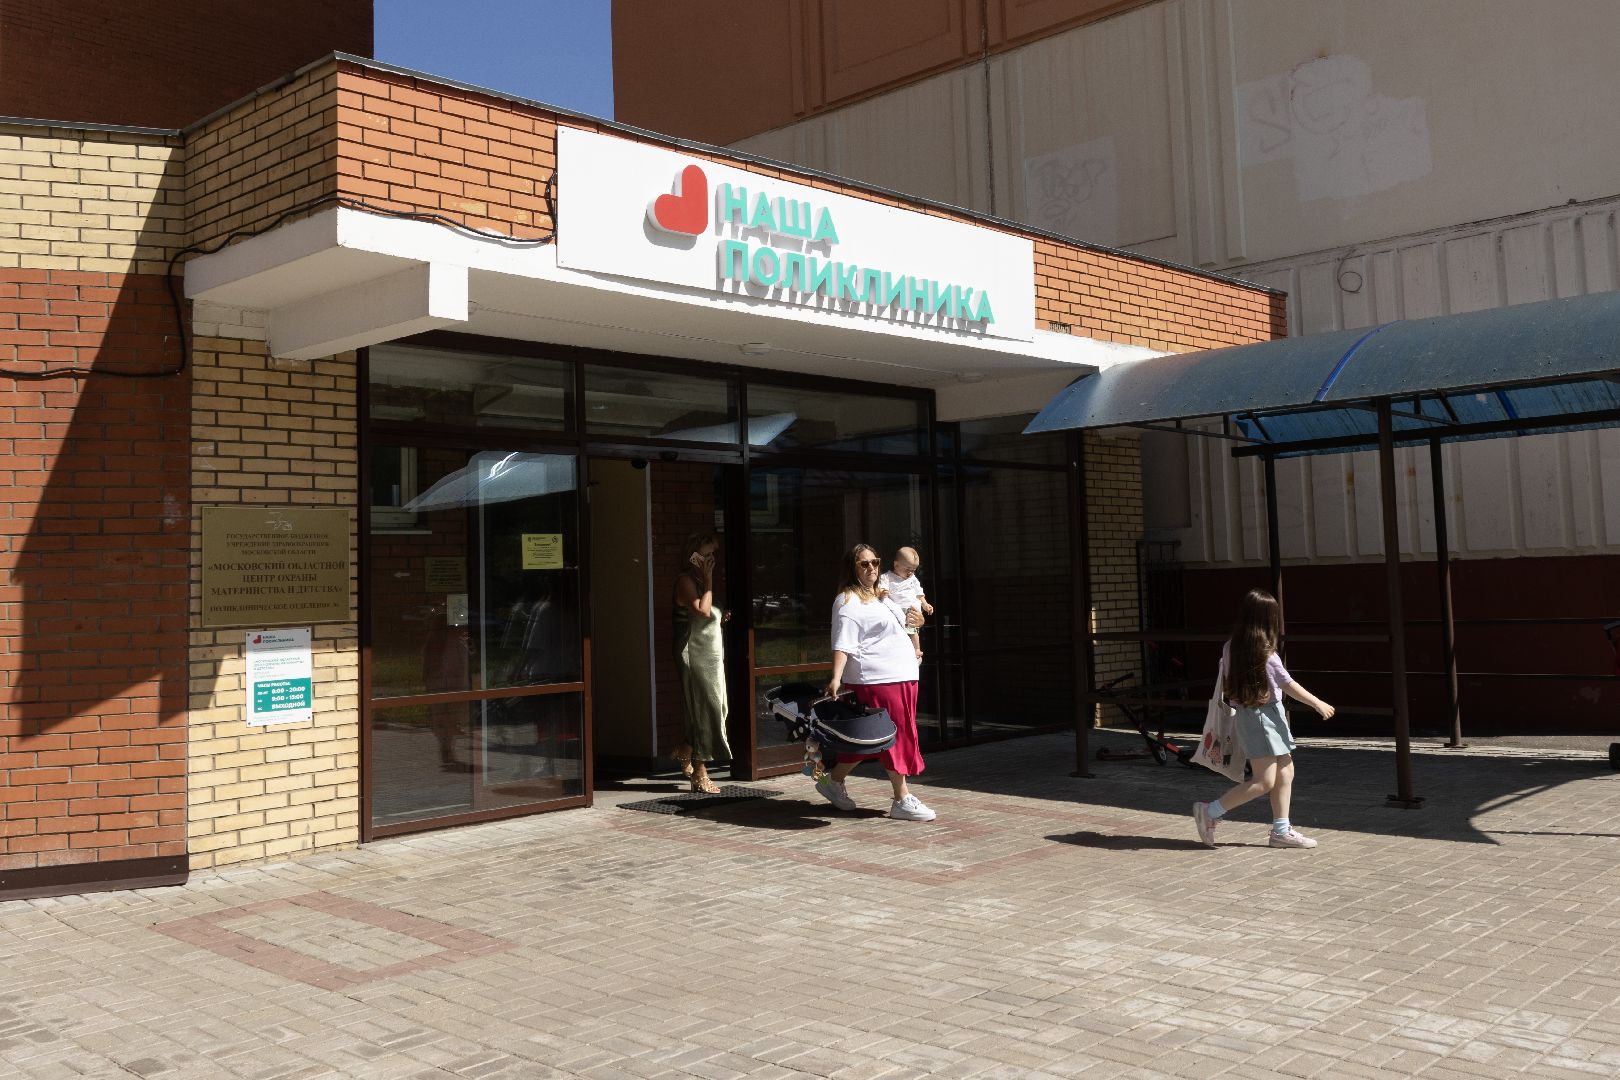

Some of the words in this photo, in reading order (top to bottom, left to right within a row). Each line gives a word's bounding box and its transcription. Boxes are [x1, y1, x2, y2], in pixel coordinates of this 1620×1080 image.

[720, 182, 839, 245] НАША
[720, 239, 995, 324] ПОЛИКЛИНИКА
[287, 560, 345, 570] ОБЛАСТНОЙ
[242, 574, 276, 583] ЦЕНТР
[277, 573, 317, 582] ОХРАНЫ
[211, 586, 286, 596] МАТЕРИНСТВА
[287, 586, 295, 594] И
[271, 700, 306, 710] ВЫХОДНОЙ
